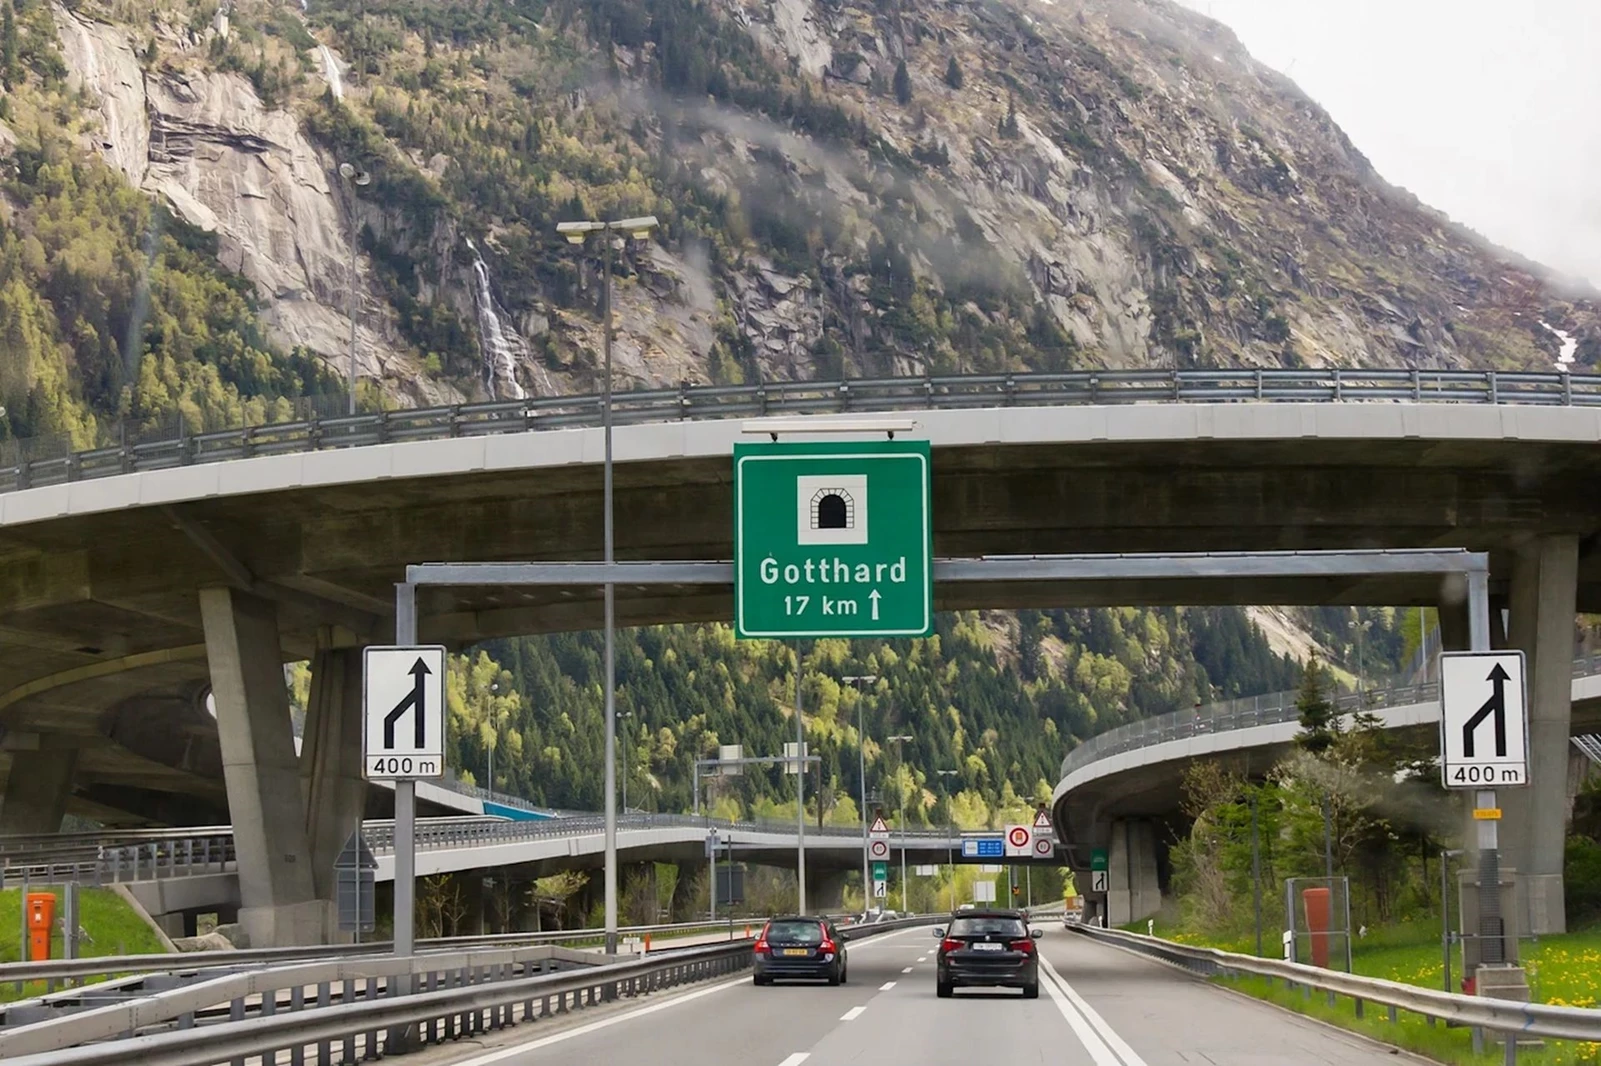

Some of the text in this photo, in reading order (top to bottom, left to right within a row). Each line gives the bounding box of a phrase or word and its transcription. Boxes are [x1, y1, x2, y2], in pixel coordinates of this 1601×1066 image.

[760, 556, 906, 584] Gotthard
[784, 595, 857, 616] 17 km
[374, 757, 435, 774] 400 m
[1454, 766, 1518, 782] 400 m
